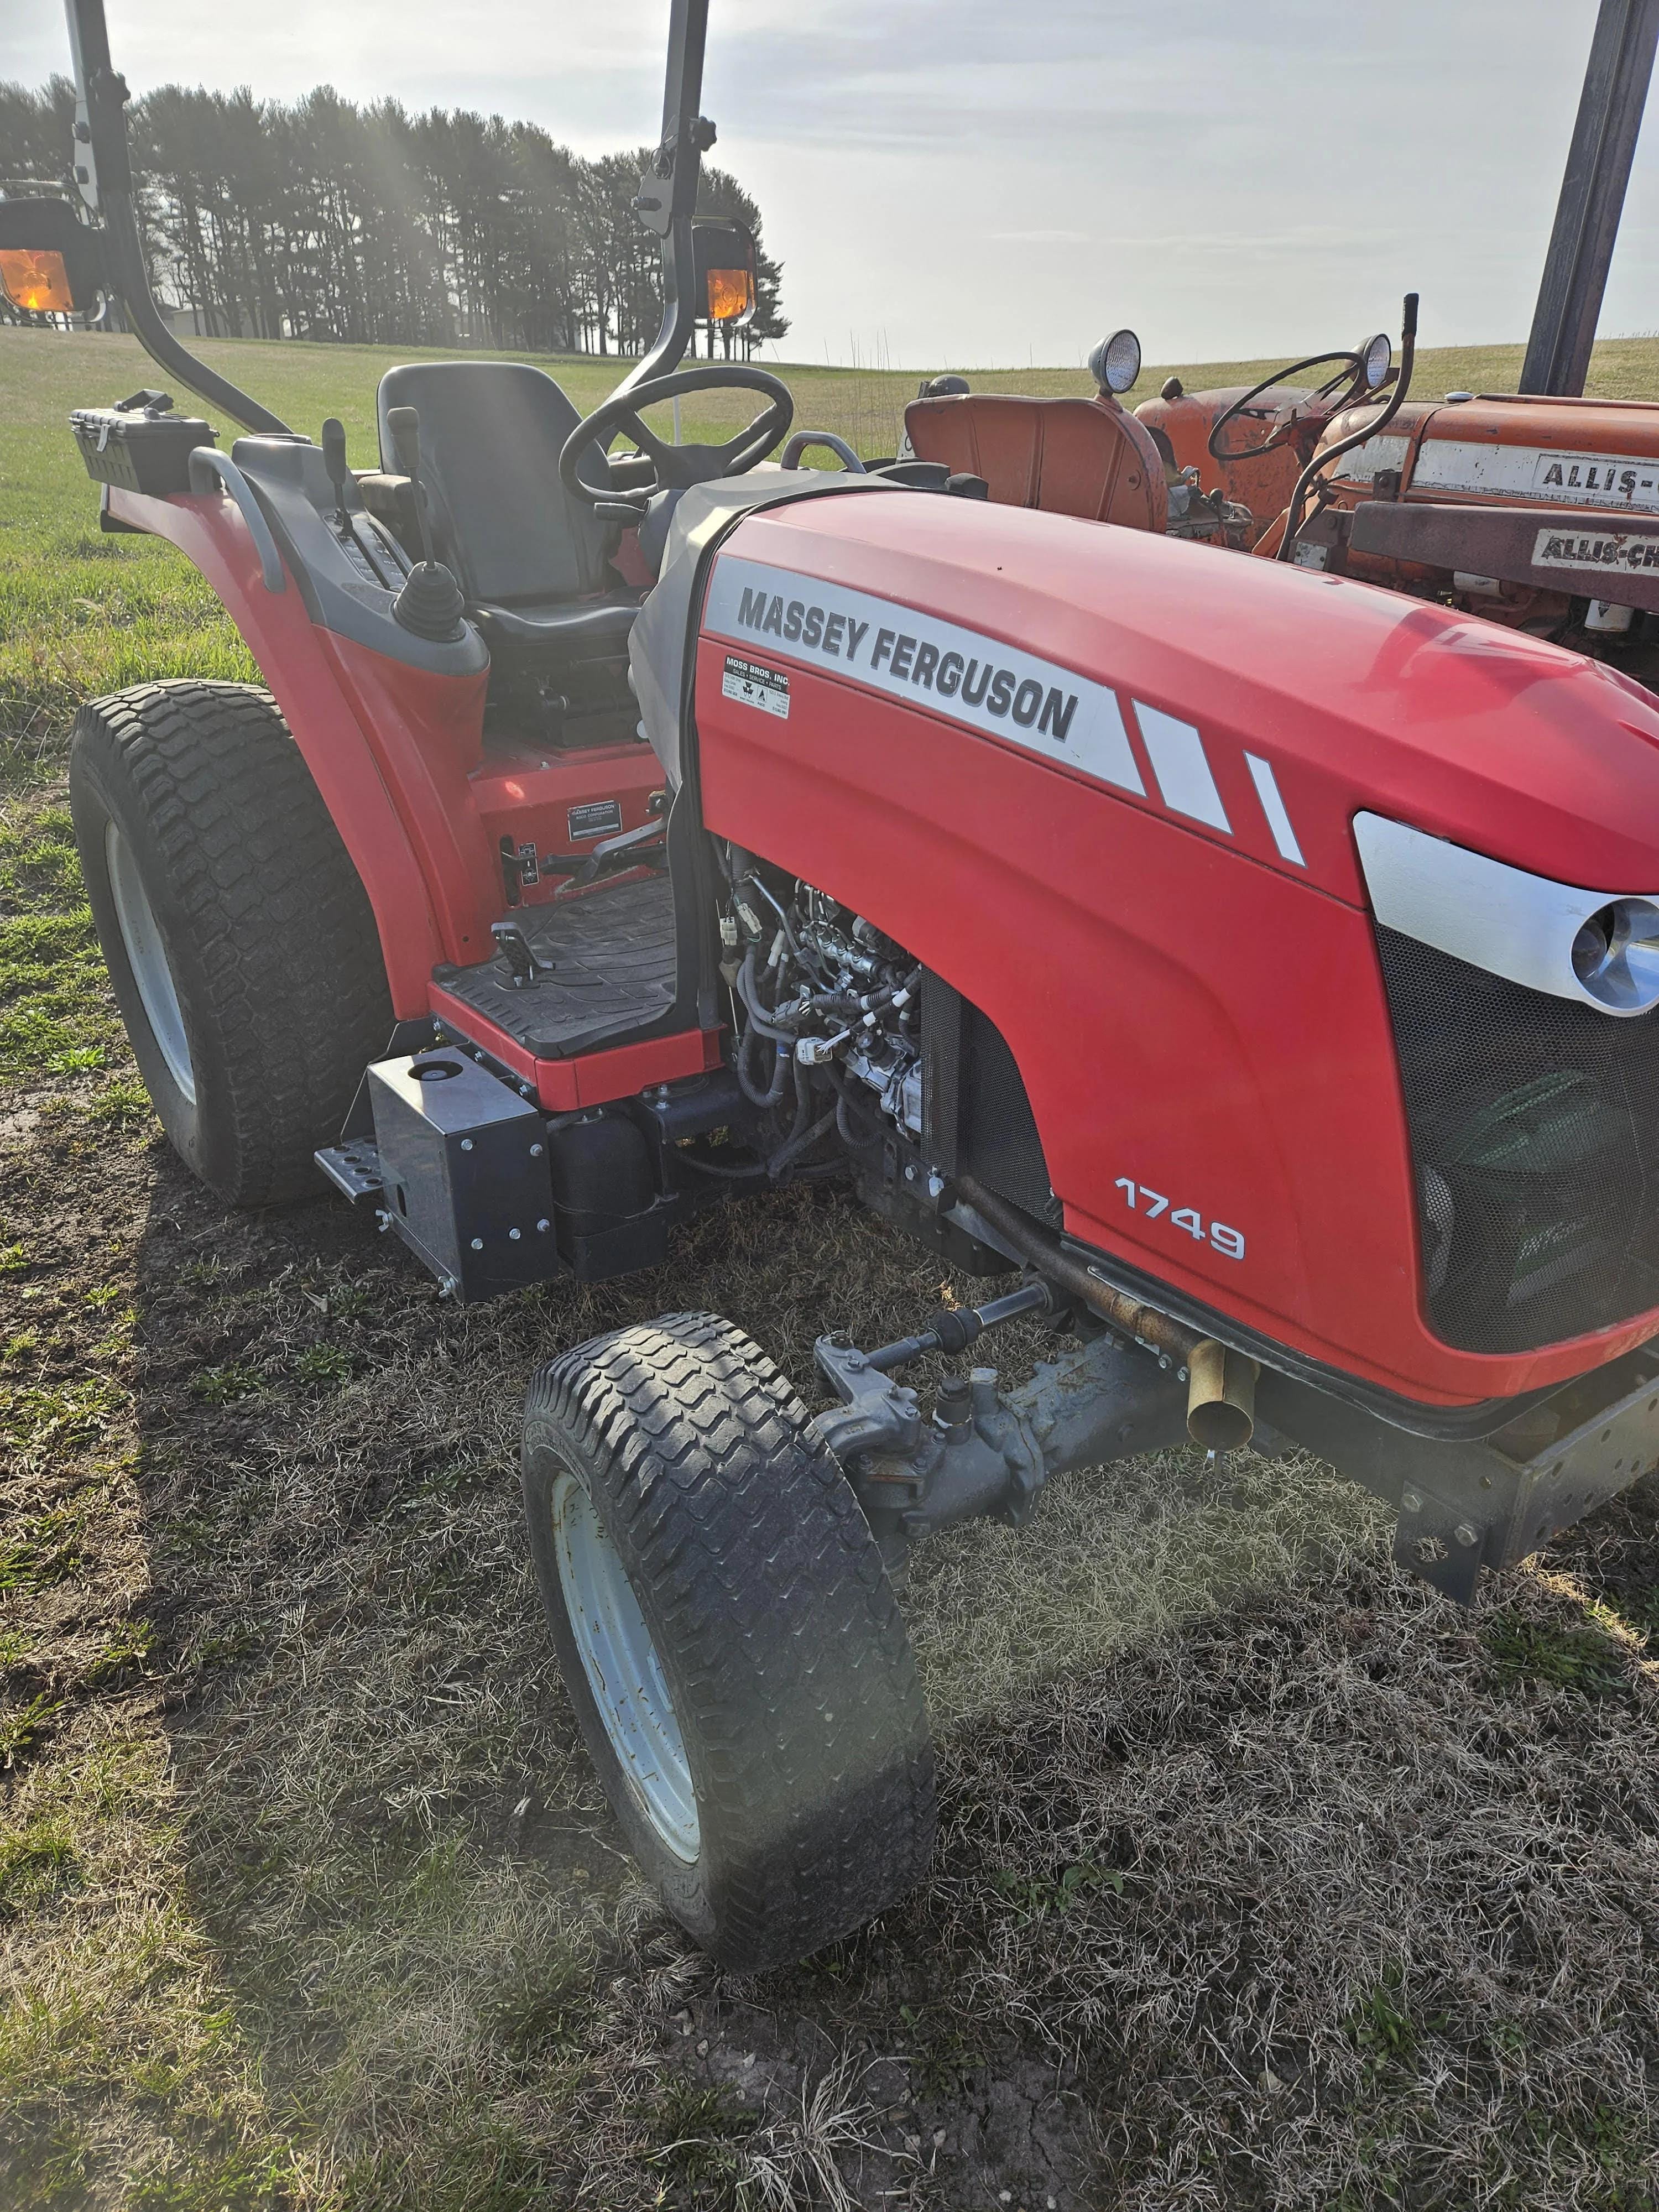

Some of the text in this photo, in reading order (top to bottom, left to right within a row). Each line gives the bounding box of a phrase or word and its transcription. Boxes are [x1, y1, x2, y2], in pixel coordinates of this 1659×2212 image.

[1542, 463, 1659, 493] ALLIS-
[726, 656, 790, 686] MOSS BROS. INC.
[733, 668, 782, 690] SALES SERVICE PARTS
[738, 587, 1078, 743] MASSEY FERGUSON
[1115, 1177, 1245, 1260] 1749
